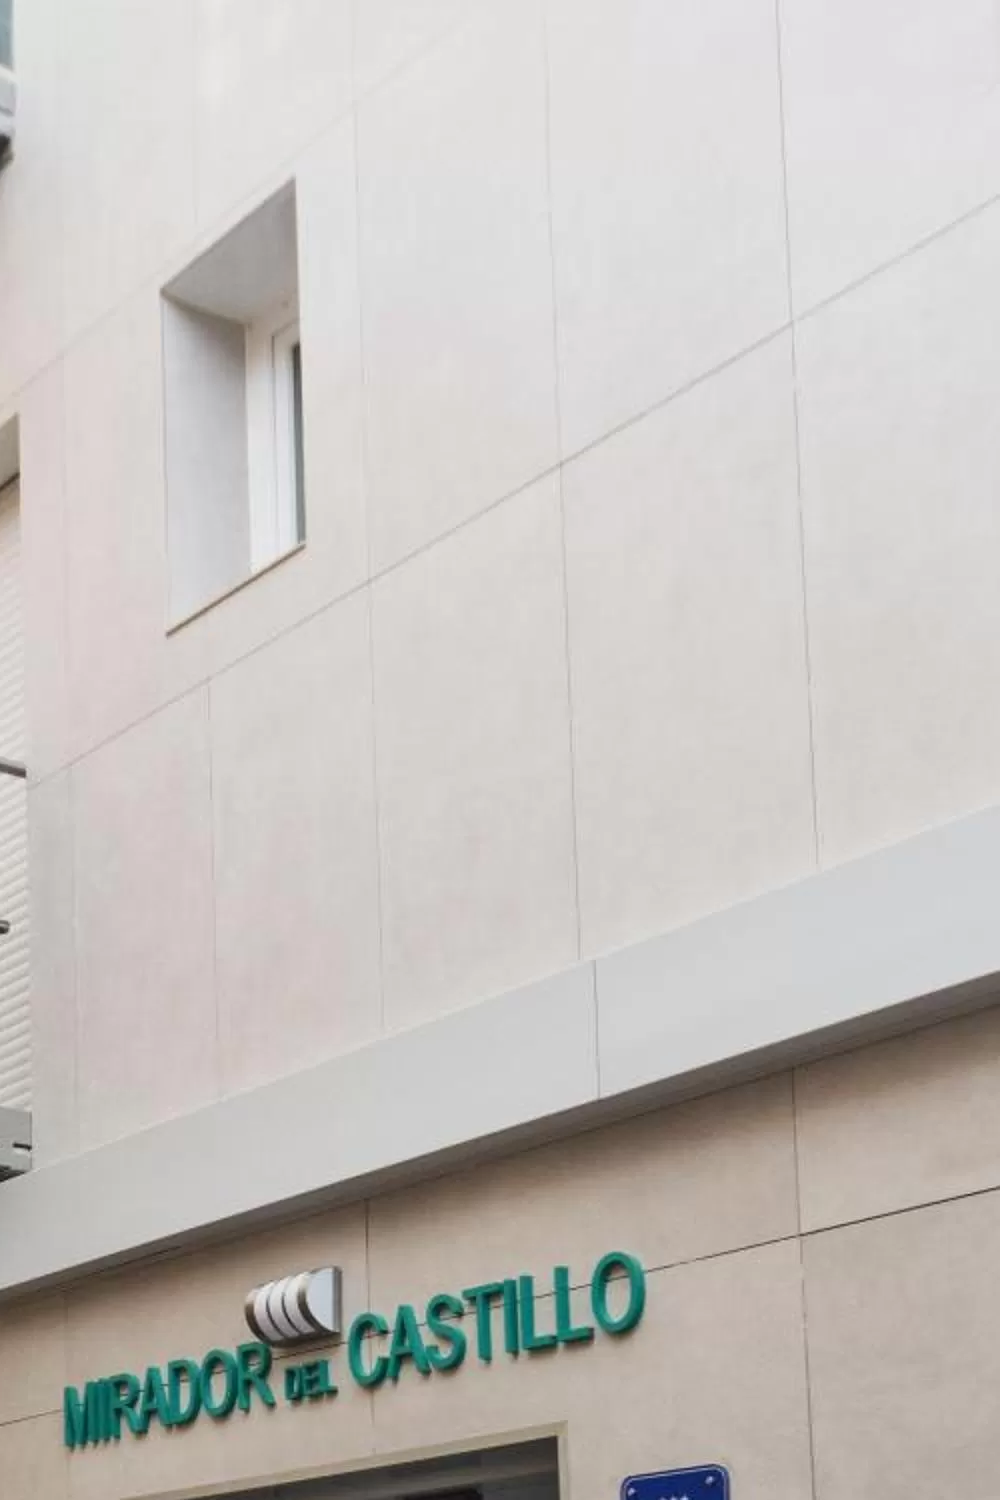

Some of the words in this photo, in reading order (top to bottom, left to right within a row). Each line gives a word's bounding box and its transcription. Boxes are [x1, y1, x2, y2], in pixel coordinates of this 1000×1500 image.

[63, 1341, 276, 1449] MIRADOR
[284, 1359, 338, 1402] DEL
[348, 1251, 646, 1390] CASTILLO
